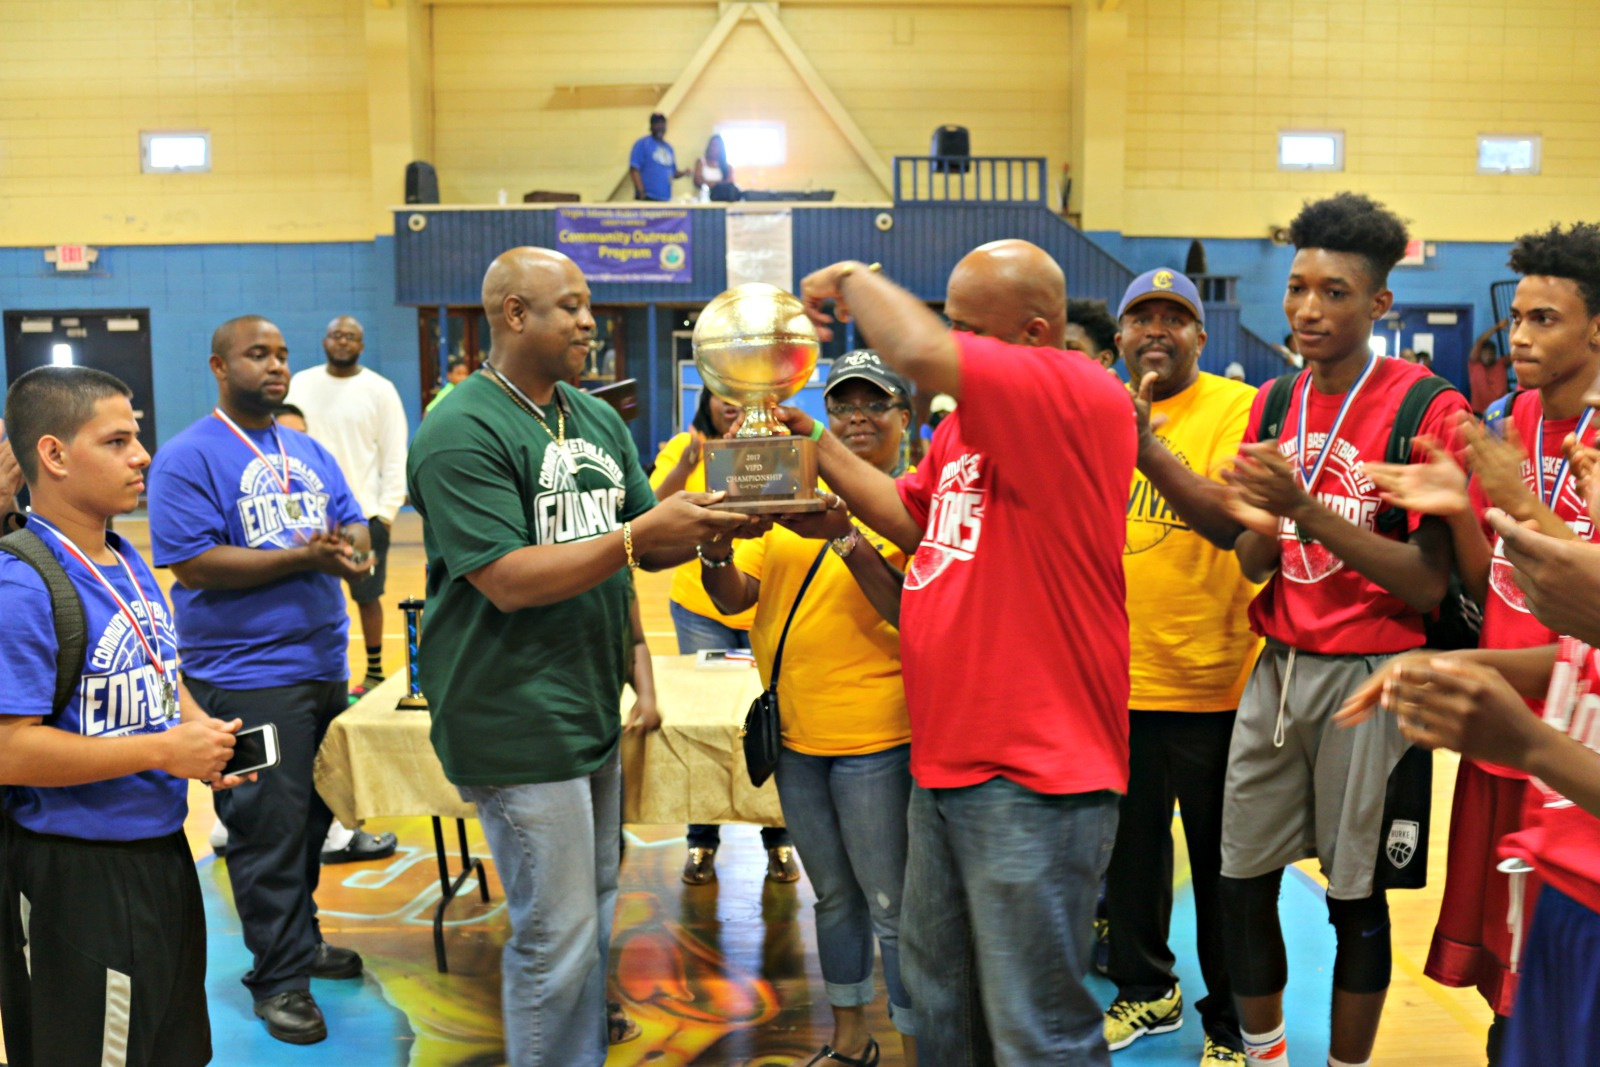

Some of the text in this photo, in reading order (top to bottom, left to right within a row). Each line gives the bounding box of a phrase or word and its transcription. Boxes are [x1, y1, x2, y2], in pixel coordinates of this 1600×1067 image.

[559, 230, 688, 245] Community Outreach
[598, 246, 652, 261] Program
[725, 474, 783, 483] CHAMPIONSHIP
